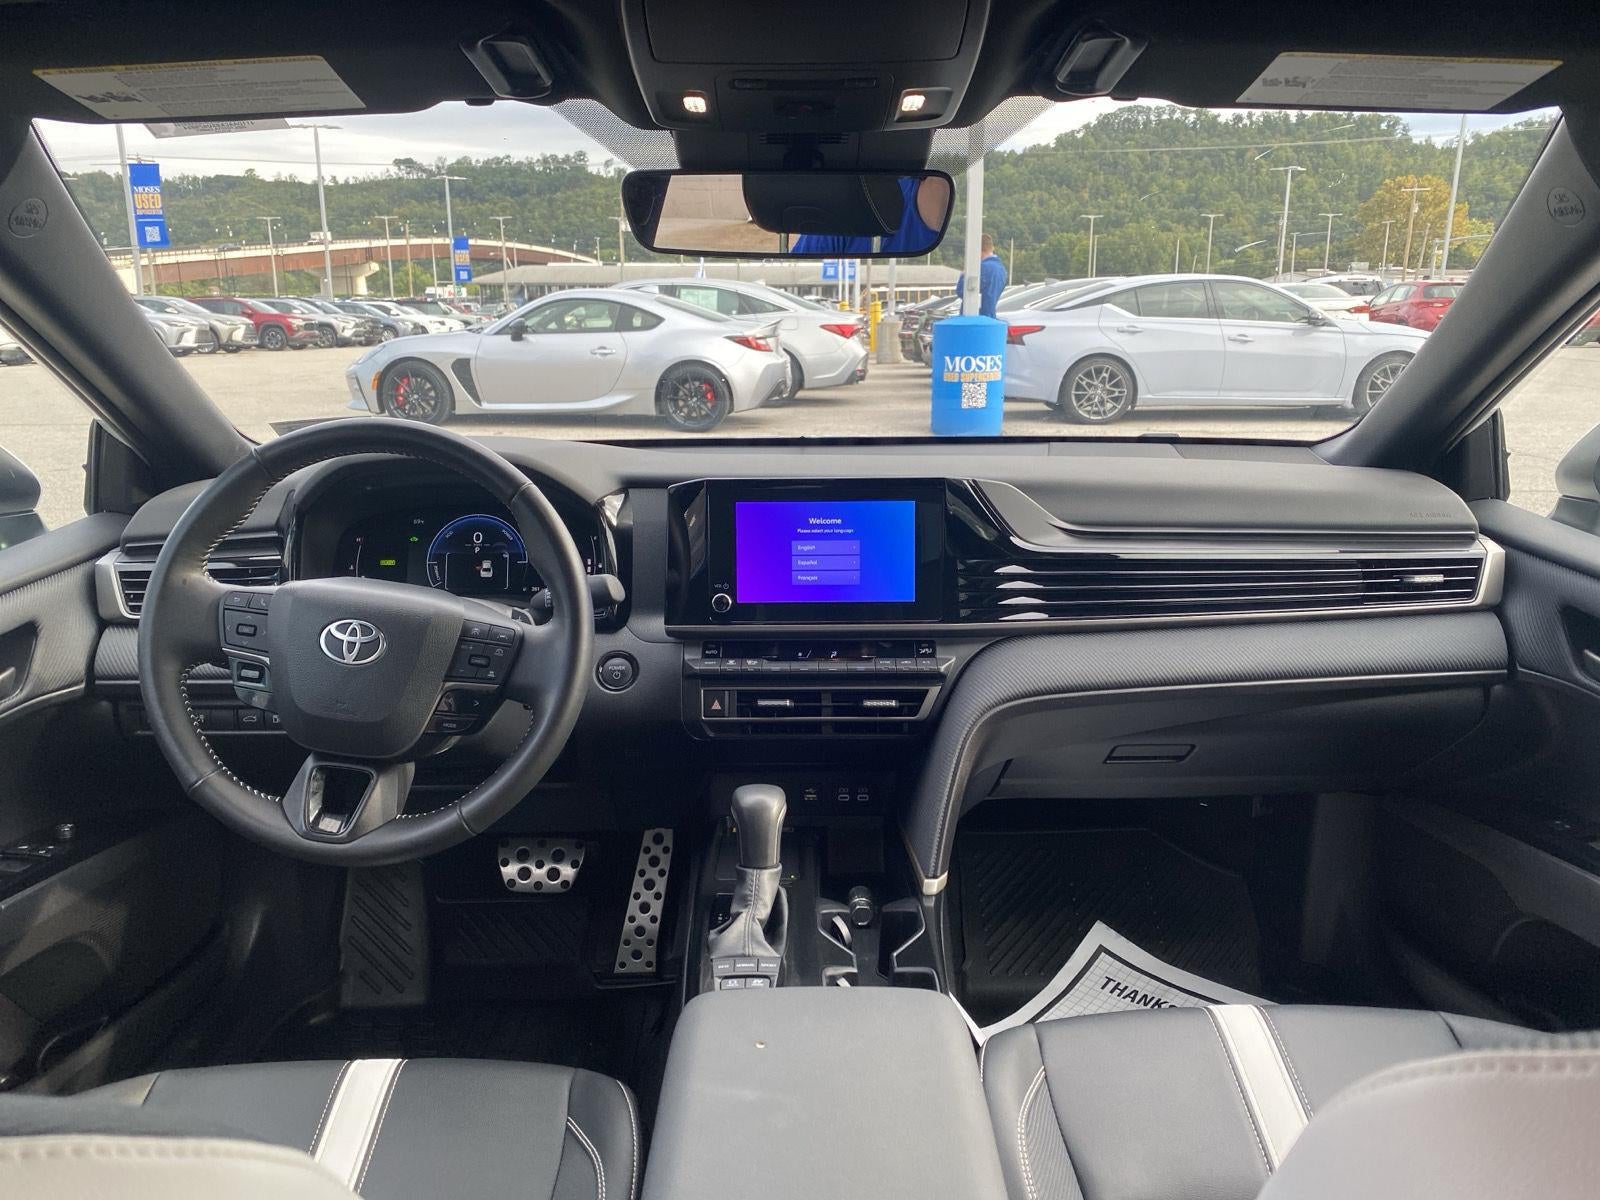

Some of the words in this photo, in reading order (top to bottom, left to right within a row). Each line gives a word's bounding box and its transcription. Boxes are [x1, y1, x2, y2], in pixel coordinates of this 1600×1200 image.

[133, 185, 160, 193] MOSES
[134, 193, 162, 209] USED
[944, 354, 1002, 373] MOSES
[808, 517, 842, 525] Welcome
[473, 531, 483, 544] 0
[1100, 975, 1179, 1009] THANK
